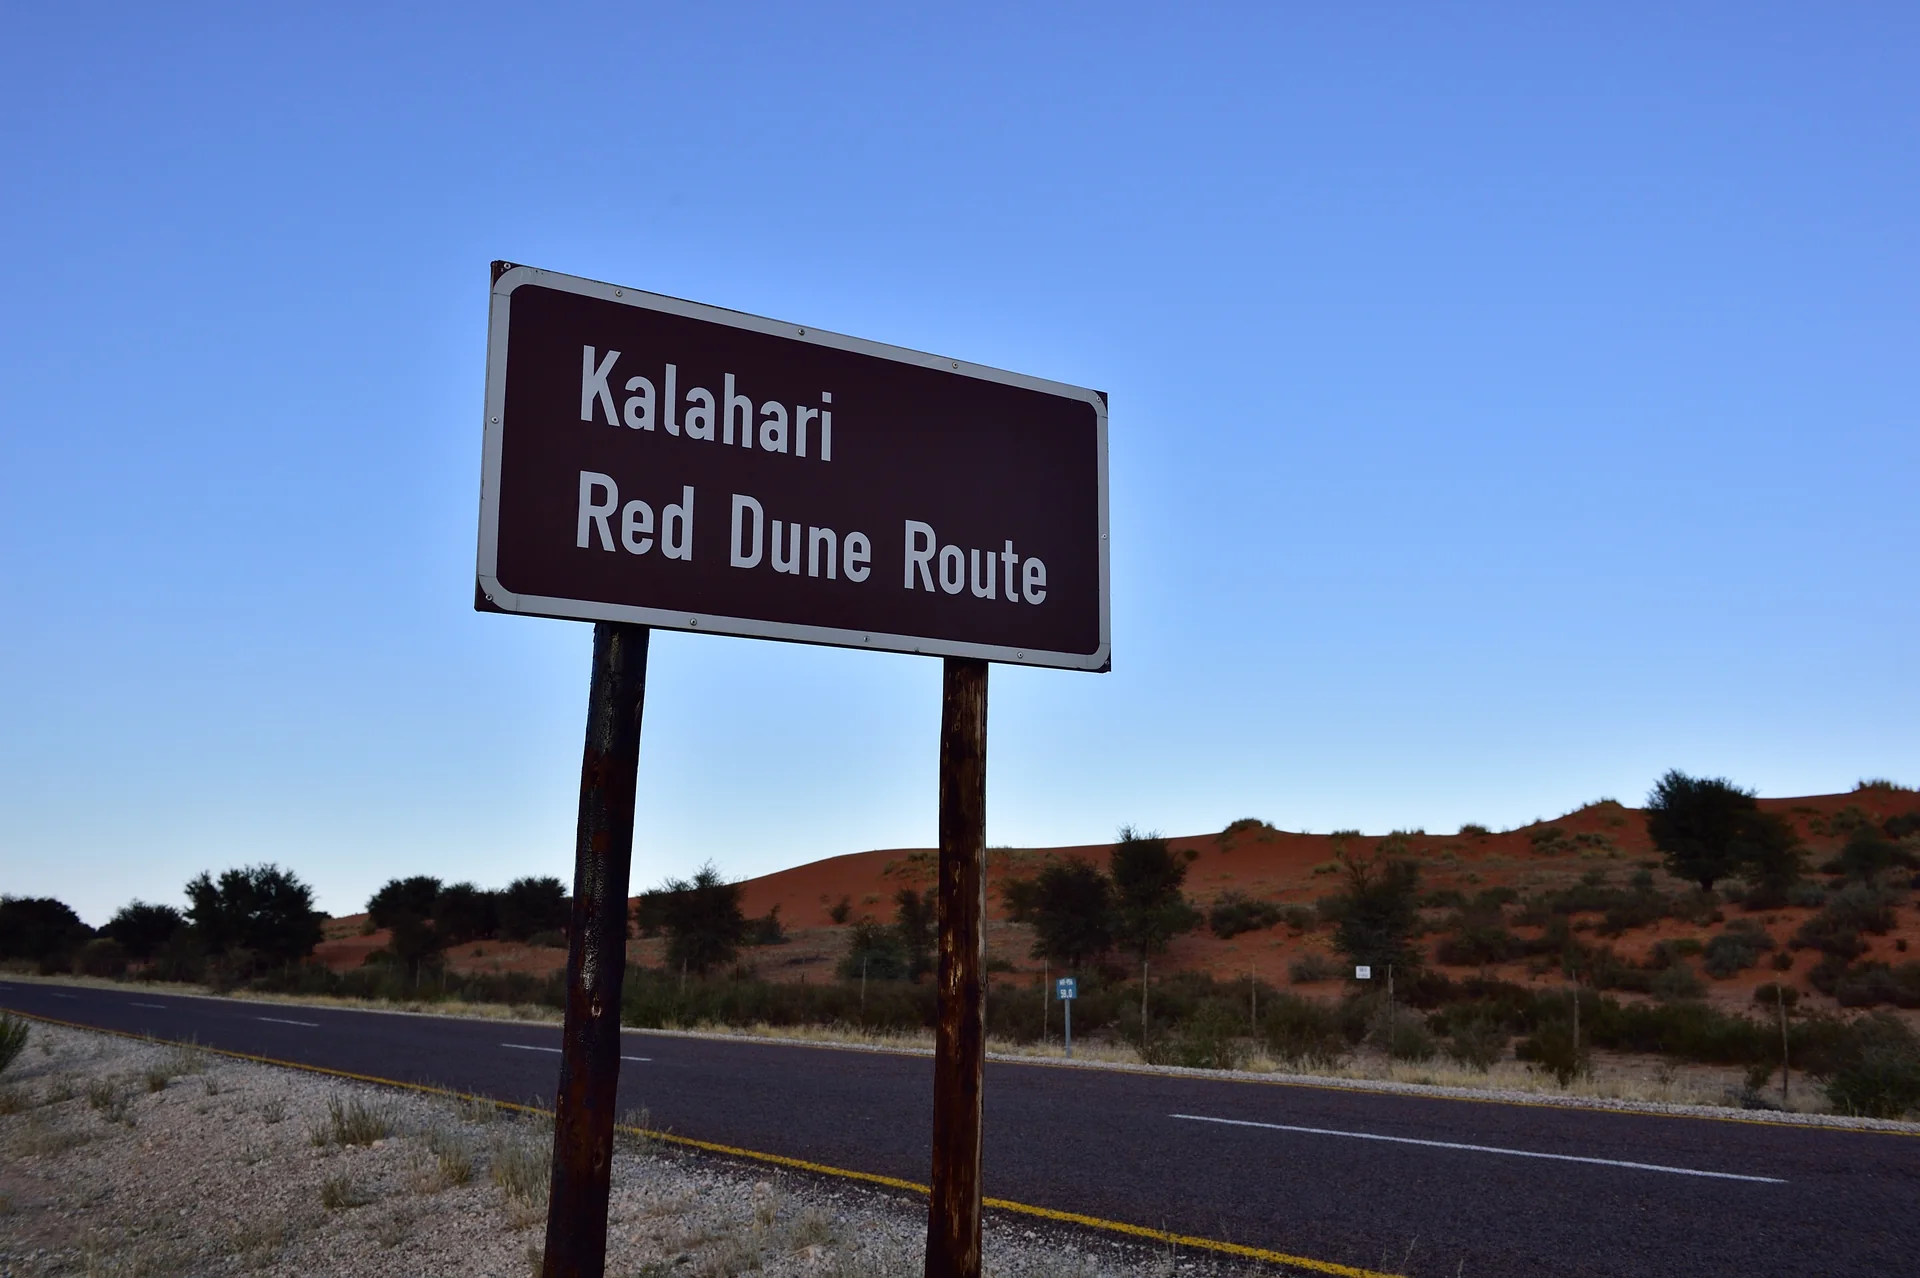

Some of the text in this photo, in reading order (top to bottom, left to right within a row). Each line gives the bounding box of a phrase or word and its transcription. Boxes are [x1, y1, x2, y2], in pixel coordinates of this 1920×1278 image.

[580, 344, 832, 462] Kalahari
[576, 470, 1048, 606] Red Dune Route
